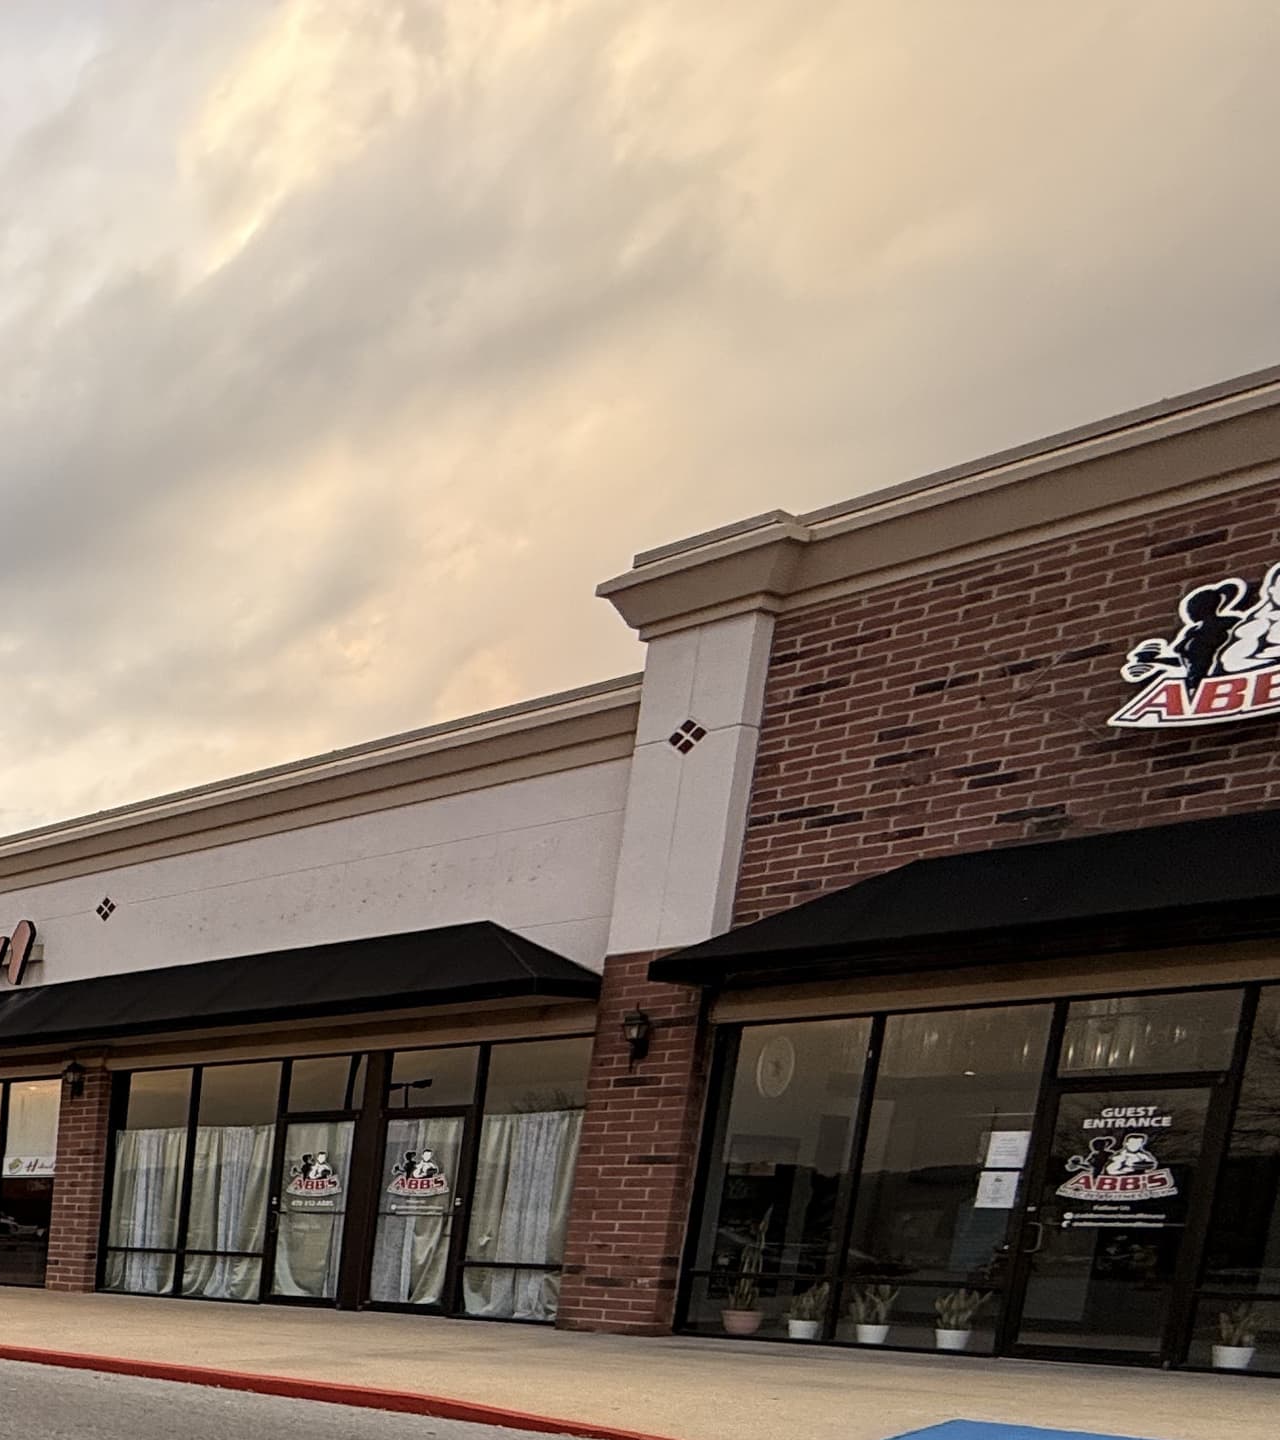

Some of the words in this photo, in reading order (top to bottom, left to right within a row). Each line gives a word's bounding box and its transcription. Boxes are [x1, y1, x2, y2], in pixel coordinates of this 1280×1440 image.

[1101, 1106, 1158, 1118] GUEST
[1082, 1116, 1173, 1129] ENTRANCE
[1063, 1169, 1172, 1193] ABB'S
